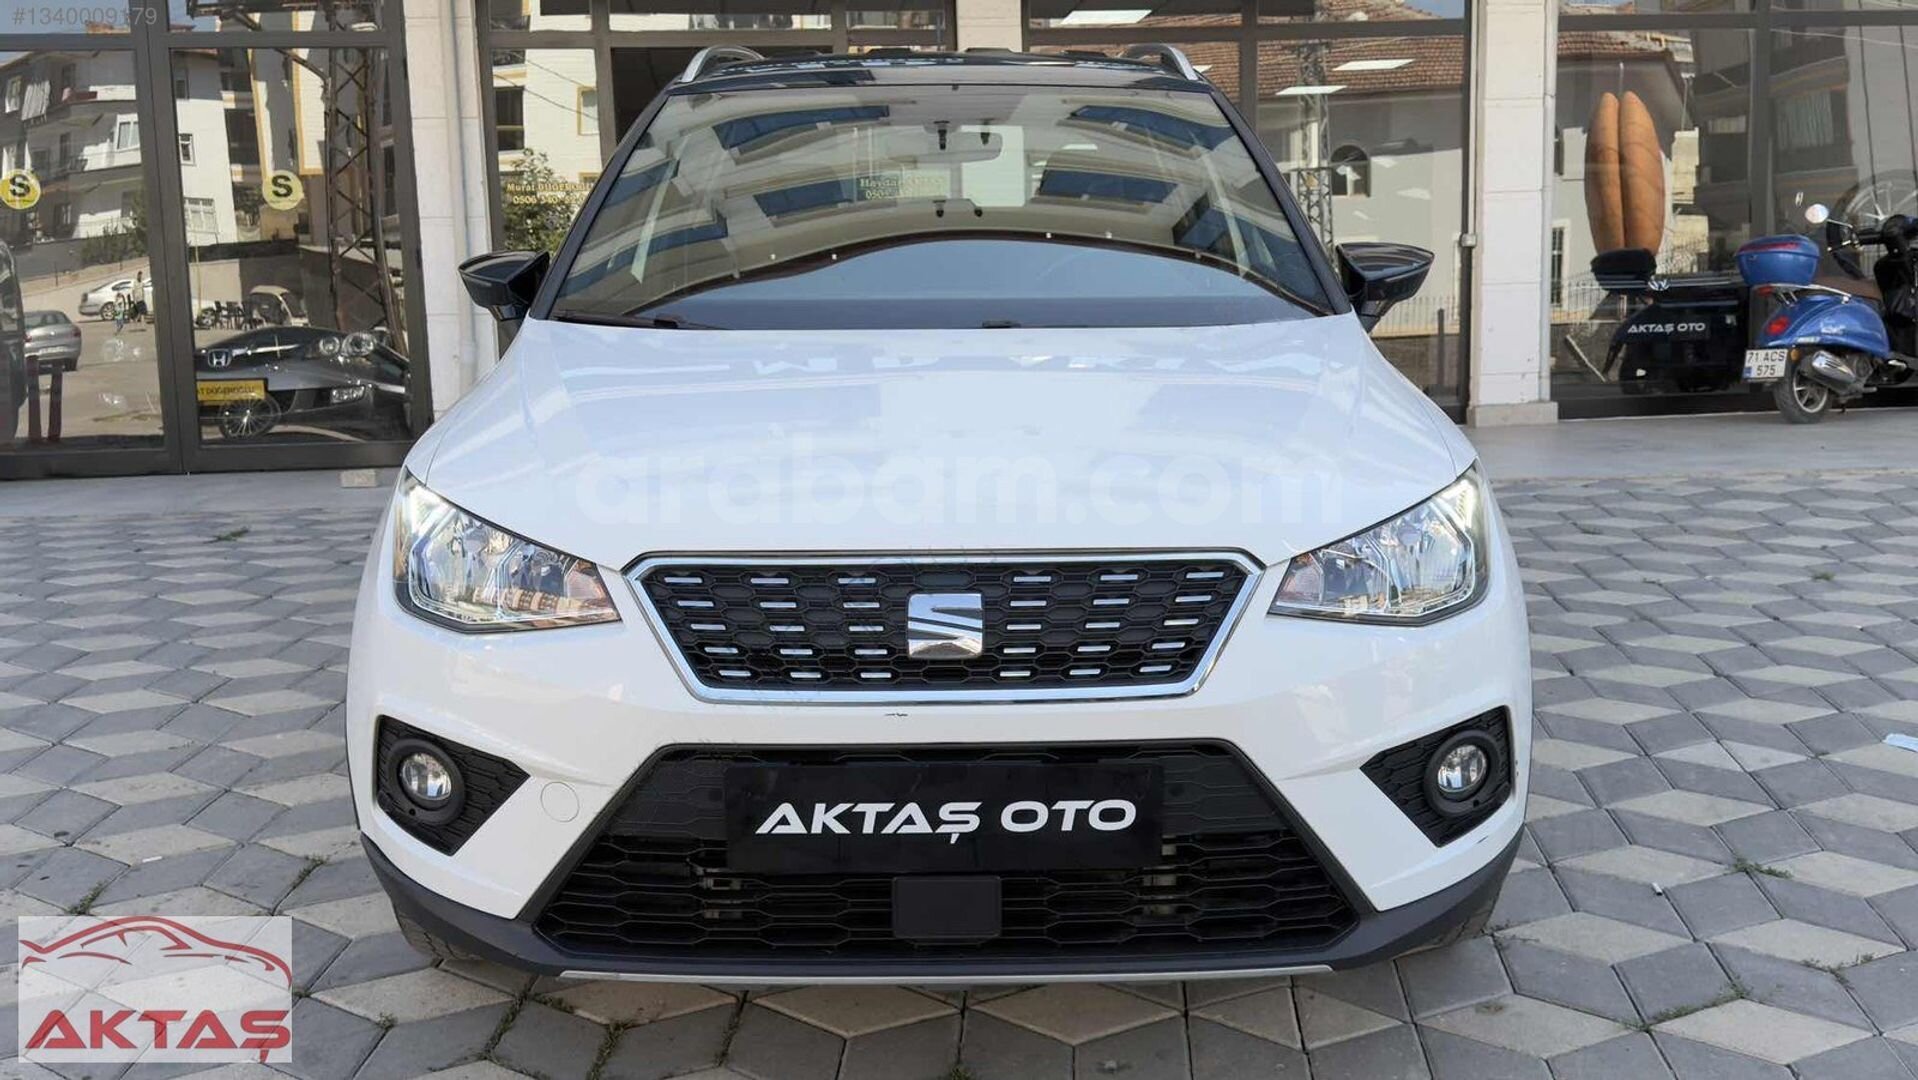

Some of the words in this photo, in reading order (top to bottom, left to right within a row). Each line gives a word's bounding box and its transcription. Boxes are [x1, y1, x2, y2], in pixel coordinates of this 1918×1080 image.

[9, 174, 30, 198] S
[271, 175, 293, 198] S
[1627, 323, 1675, 335] AKTAŞ
[1677, 322, 1706, 332] OTO
[1747, 351, 1759, 363] 71
[1763, 350, 1785, 362] ACS
[1756, 364, 1777, 376] 575
[755, 801, 982, 844] AKTAŞ
[1000, 799, 1137, 832] OTO
